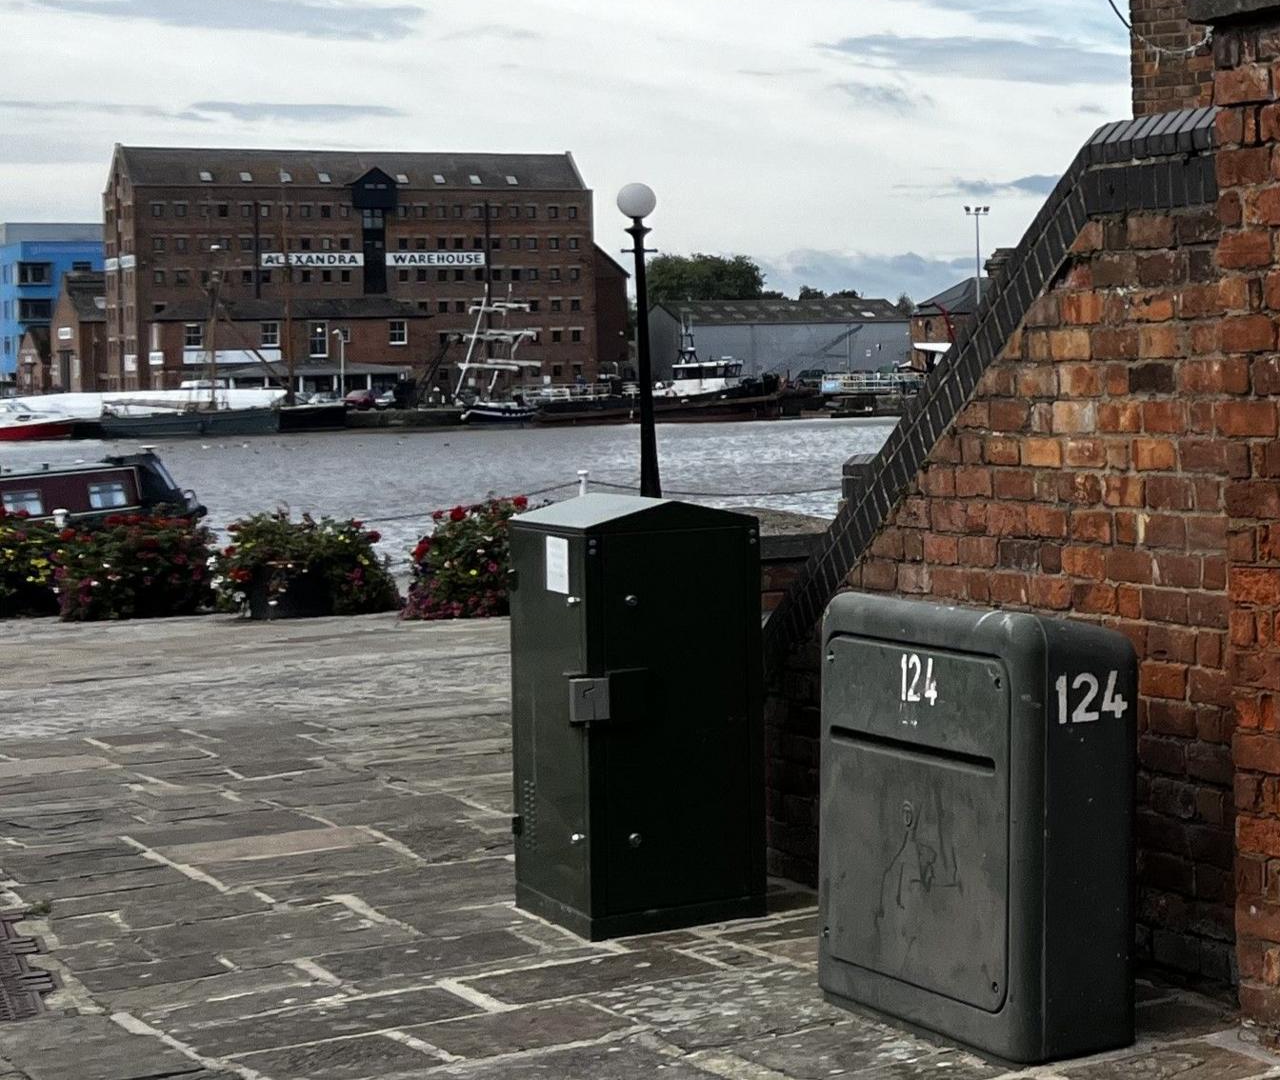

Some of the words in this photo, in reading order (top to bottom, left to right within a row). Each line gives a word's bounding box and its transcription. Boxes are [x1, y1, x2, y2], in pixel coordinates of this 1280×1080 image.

[265, 254, 358, 265] ALEXANDRA
[393, 253, 482, 264] WAREHOUSE
[901, 653, 938, 706] 124
[1055, 670, 1128, 725] 124
